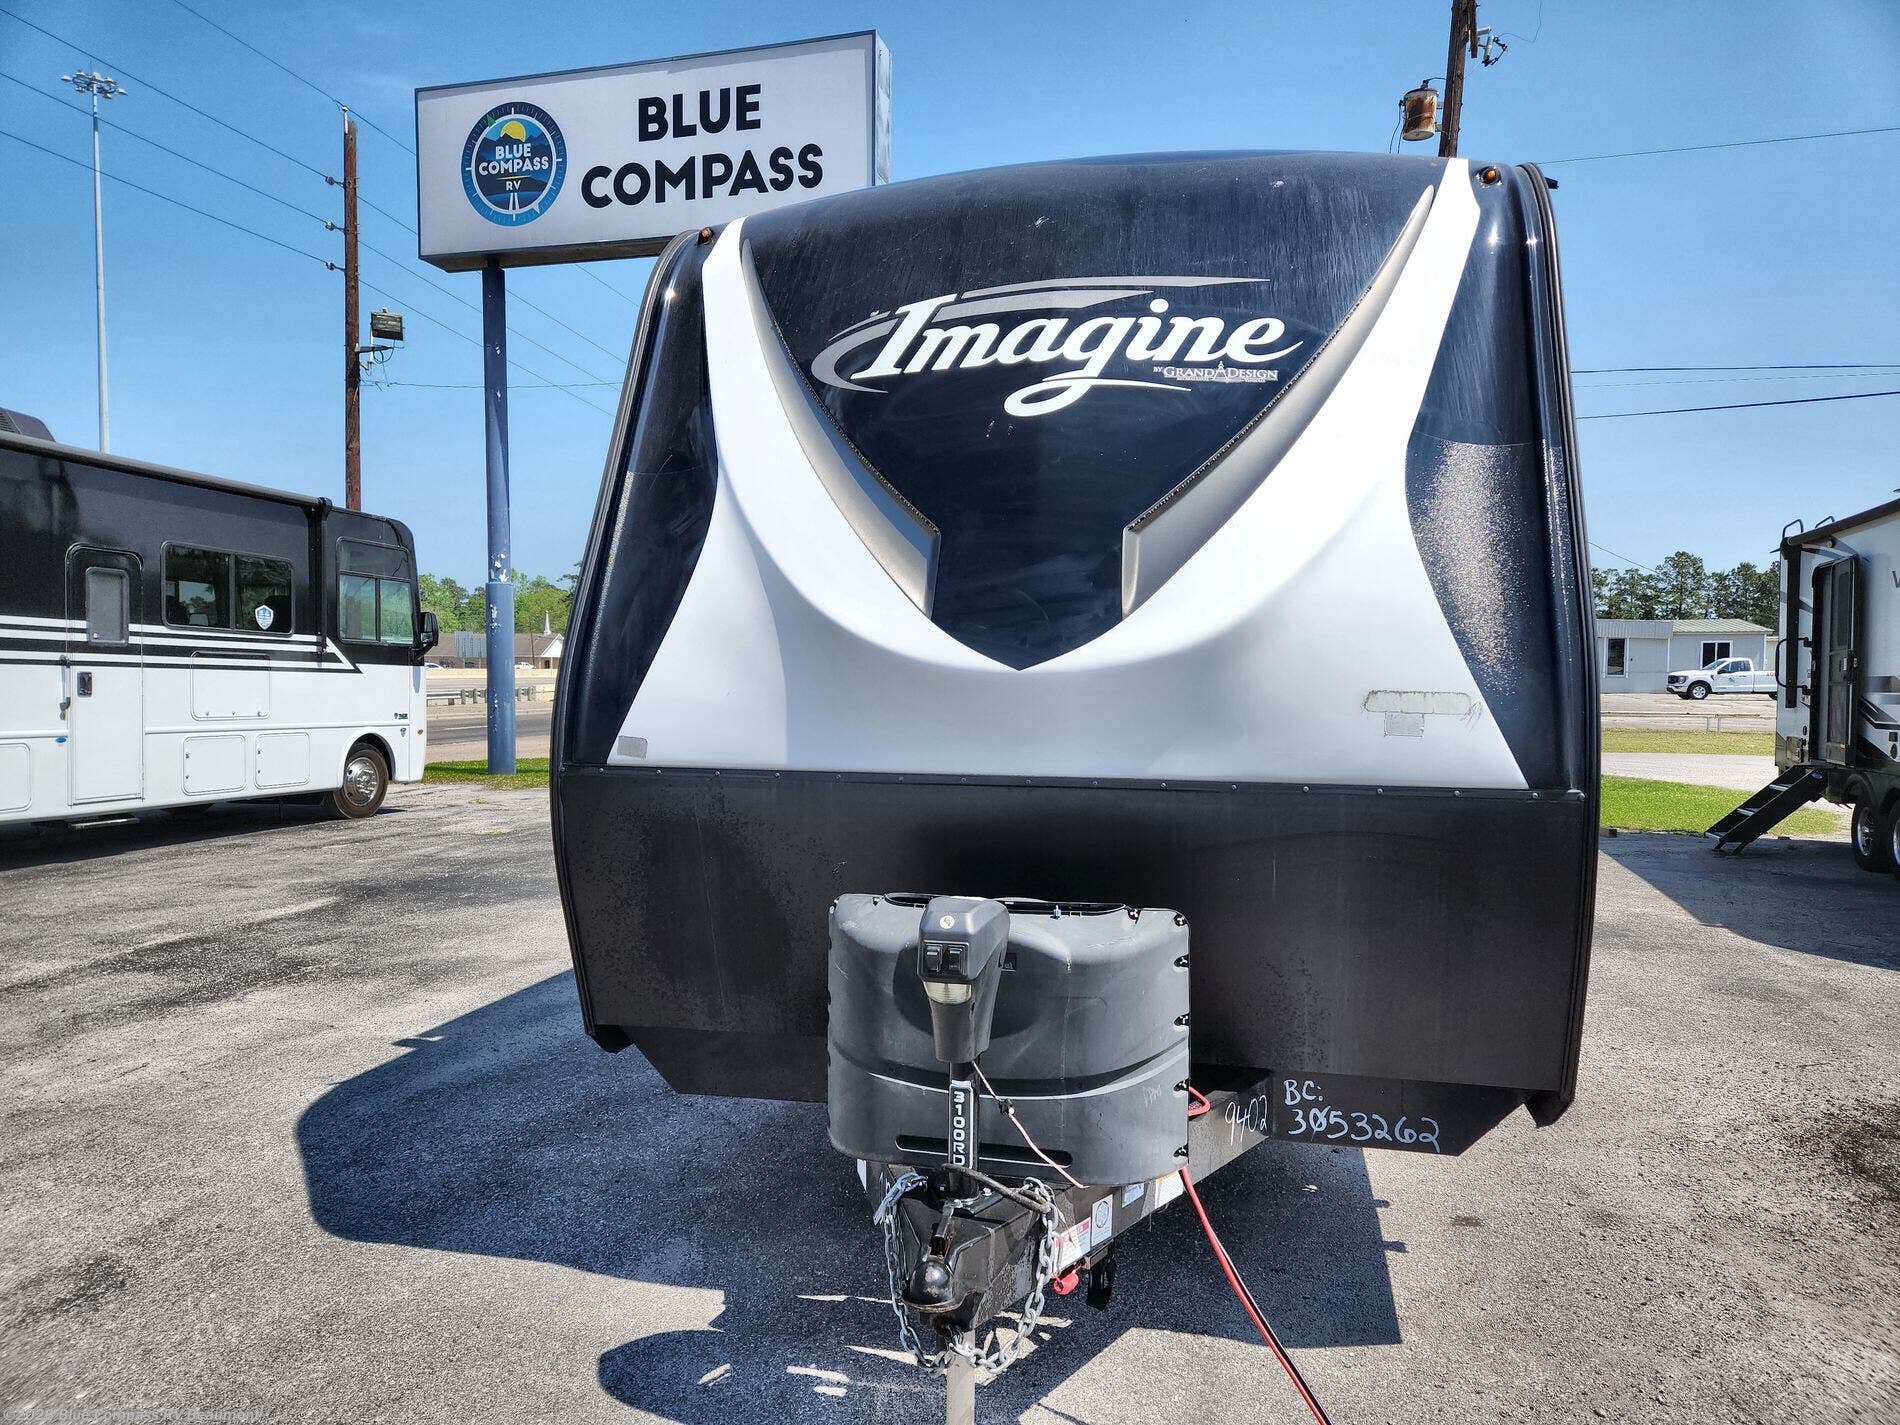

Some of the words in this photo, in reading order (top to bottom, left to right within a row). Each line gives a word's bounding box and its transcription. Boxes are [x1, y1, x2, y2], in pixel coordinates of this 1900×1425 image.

[638, 84, 761, 142] BLUE
[478, 156, 549, 176] COMPASS
[495, 143, 531, 160] BLUE
[581, 143, 824, 209] COMPASS
[505, 180, 521, 191] RV
[850, 293, 1304, 417] Imagine
[1163, 366, 1216, 378] GRAND
[1227, 367, 1279, 381] DESIGN
[952, 1090, 966, 1167] 3100RD
[1224, 1094, 1268, 1146] 9402
